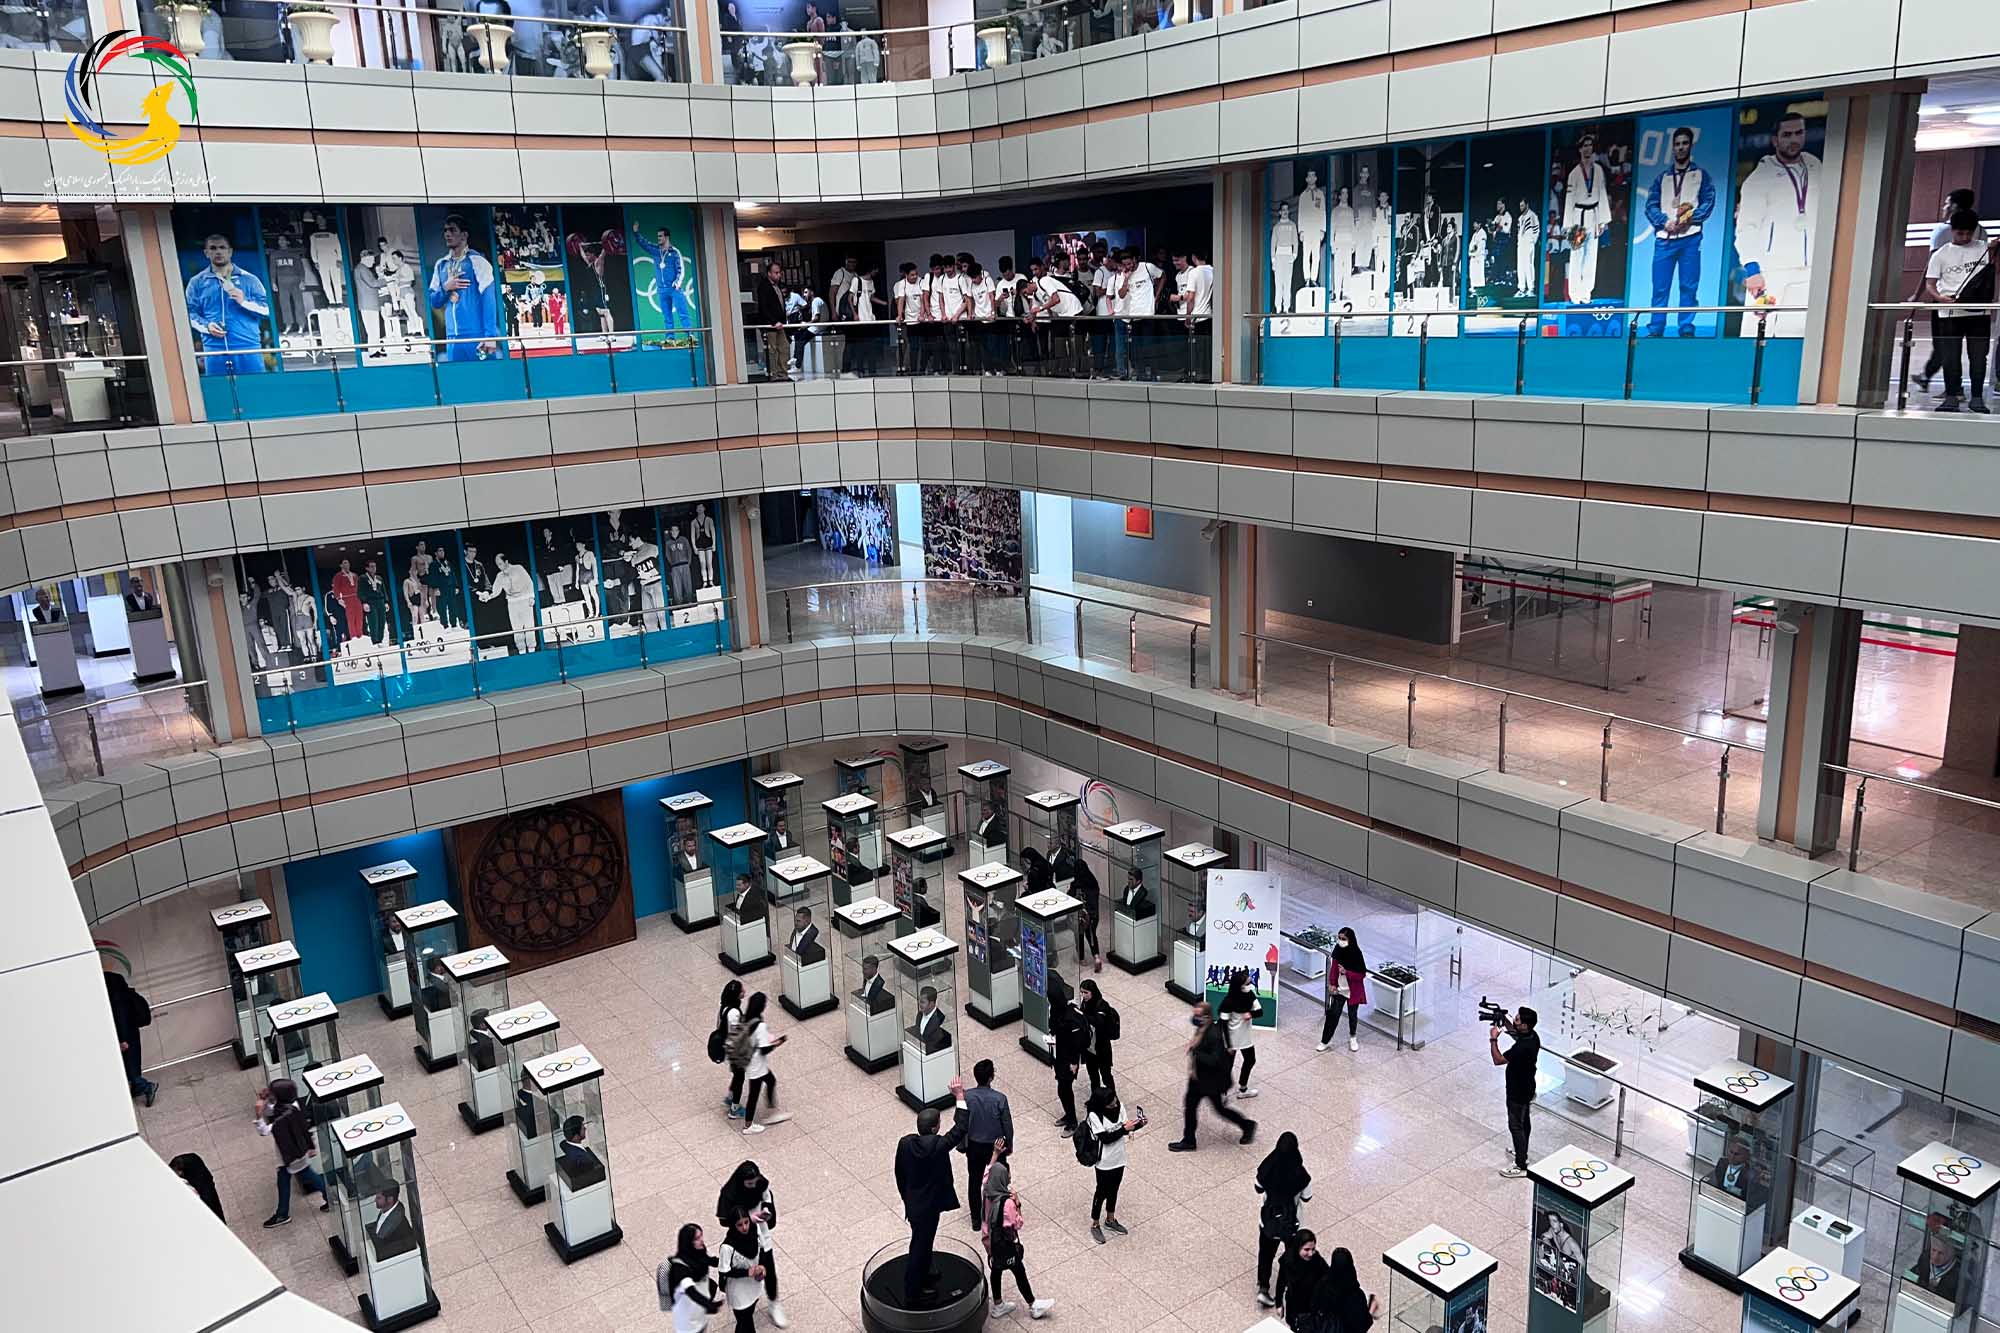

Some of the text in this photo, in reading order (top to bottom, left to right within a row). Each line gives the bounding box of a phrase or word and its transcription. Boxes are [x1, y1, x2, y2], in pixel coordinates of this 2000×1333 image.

[418, 625, 424, 640] 1
[586, 624, 596, 639] 3
[345, 643, 351, 657] 1
[1247, 921, 1273, 930] OLYMPIC
[1233, 942, 1254, 951] 2022
